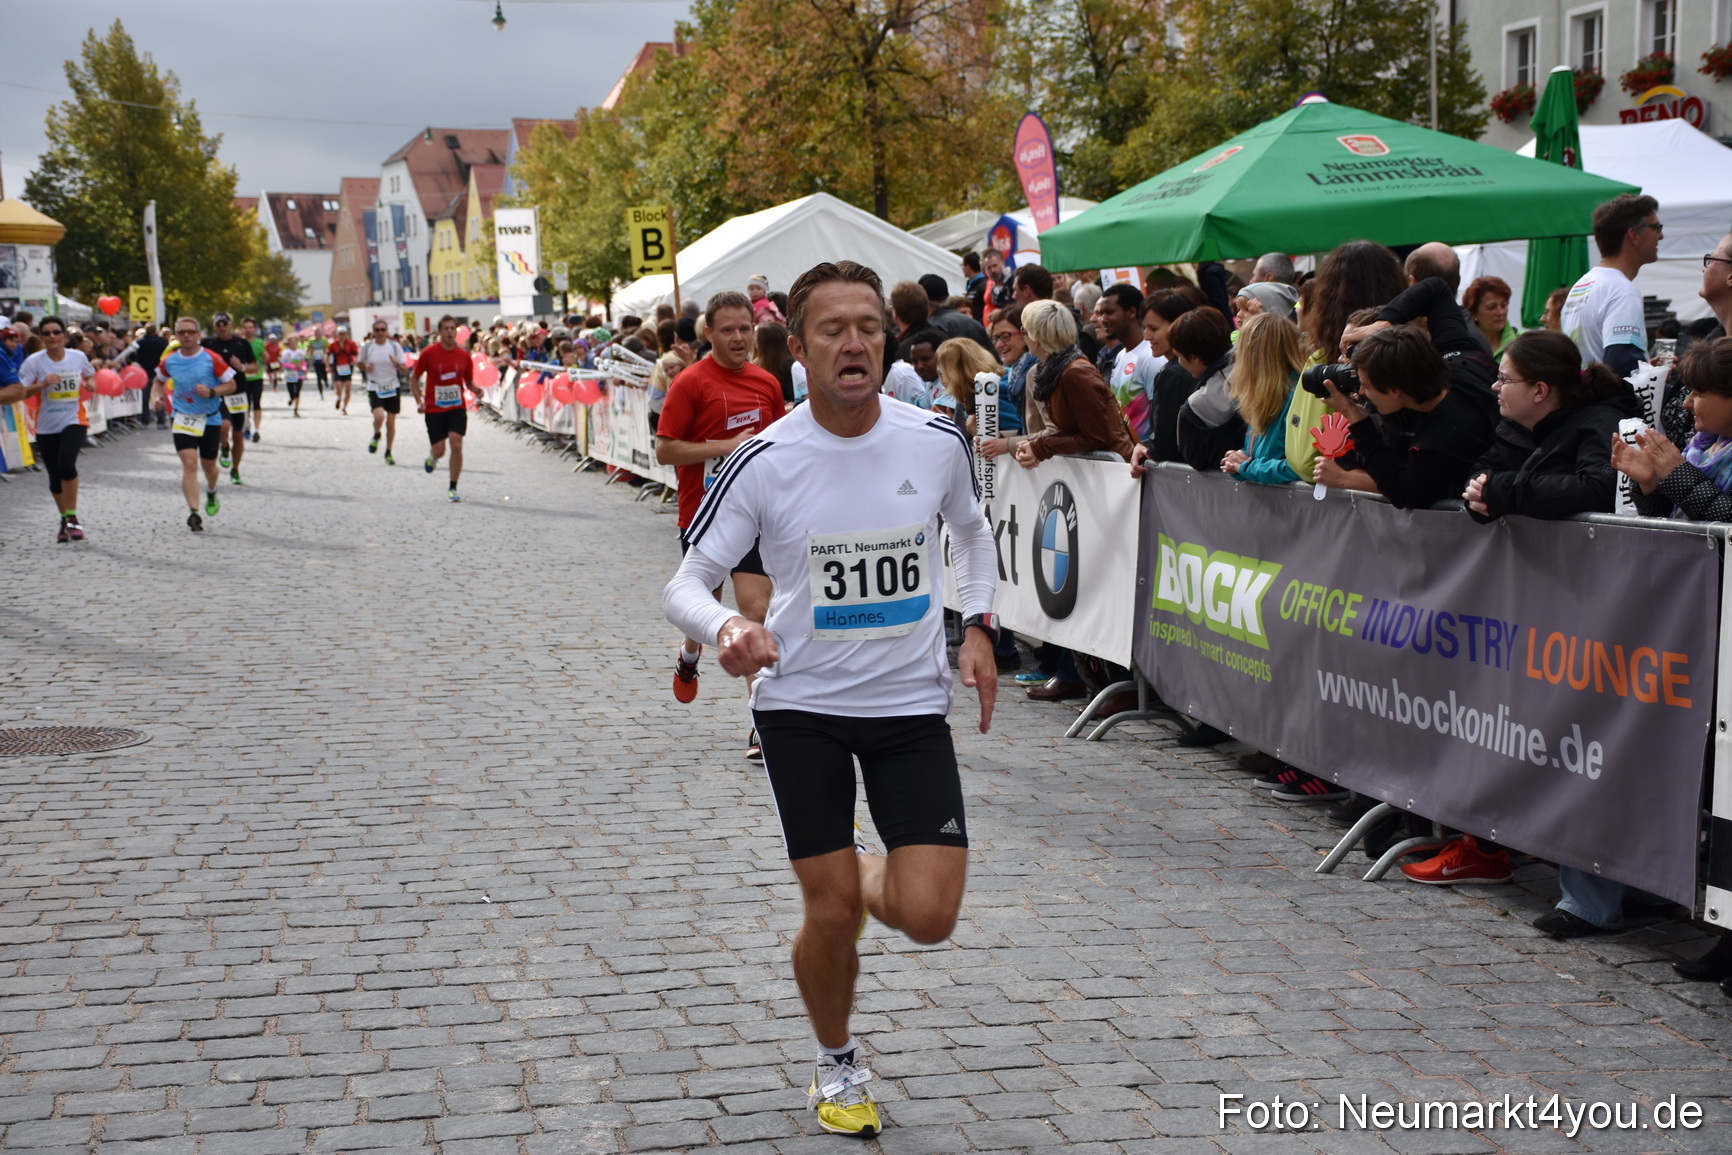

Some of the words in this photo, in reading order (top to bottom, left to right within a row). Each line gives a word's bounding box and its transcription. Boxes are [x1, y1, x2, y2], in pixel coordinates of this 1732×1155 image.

[1322, 157, 1445, 172] Neumarkter
[1306, 165, 1484, 186] Lammsbräu
[633, 209, 669, 223] Block
[641, 228, 665, 262] B
[136, 296, 148, 313] C
[438, 391, 459, 401] 2303
[183, 416, 197, 427] 57
[985, 404, 997, 437] BMW
[811, 544, 852, 556] PARTL
[855, 538, 912, 553] Neumarkt
[823, 552, 920, 601] 3106
[1157, 544, 1272, 636] BOCK
[826, 611, 885, 626] Hannes
[1149, 614, 1192, 646] inspired
[1200, 639, 1224, 664] smart
[1226, 649, 1272, 683] concepts
[1279, 579, 1363, 637] OFFICE
[1362, 598, 1520, 671] INDUSTRY
[1526, 627, 1693, 709] LOUNGE
[1317, 669, 1604, 780] www.bockonline.de
